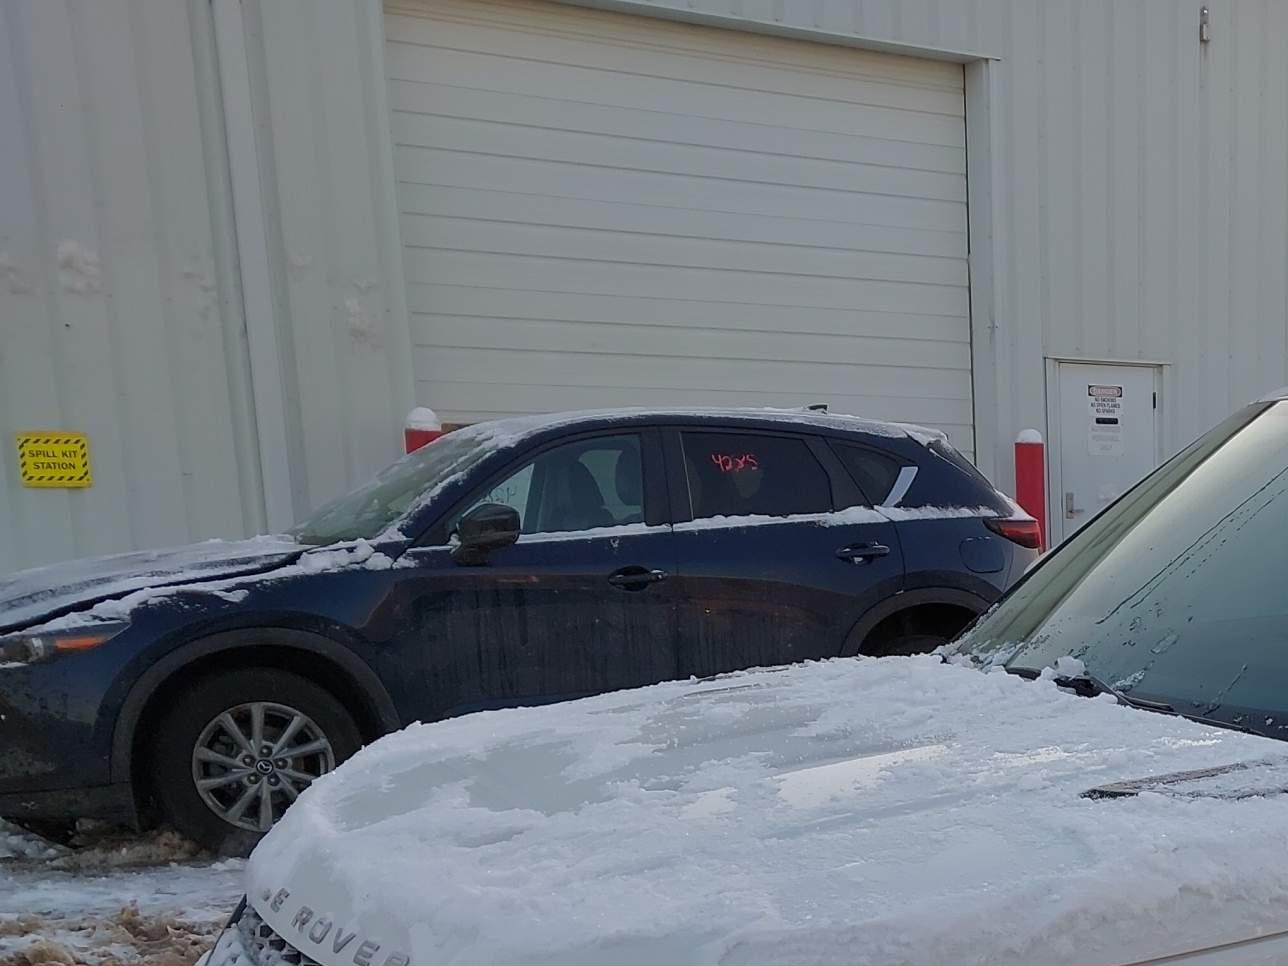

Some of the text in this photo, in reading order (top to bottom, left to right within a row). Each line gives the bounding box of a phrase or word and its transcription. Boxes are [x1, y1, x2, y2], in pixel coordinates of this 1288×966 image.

[28, 449, 78, 458] SPILL KIT
[33, 461, 76, 470] STATION
